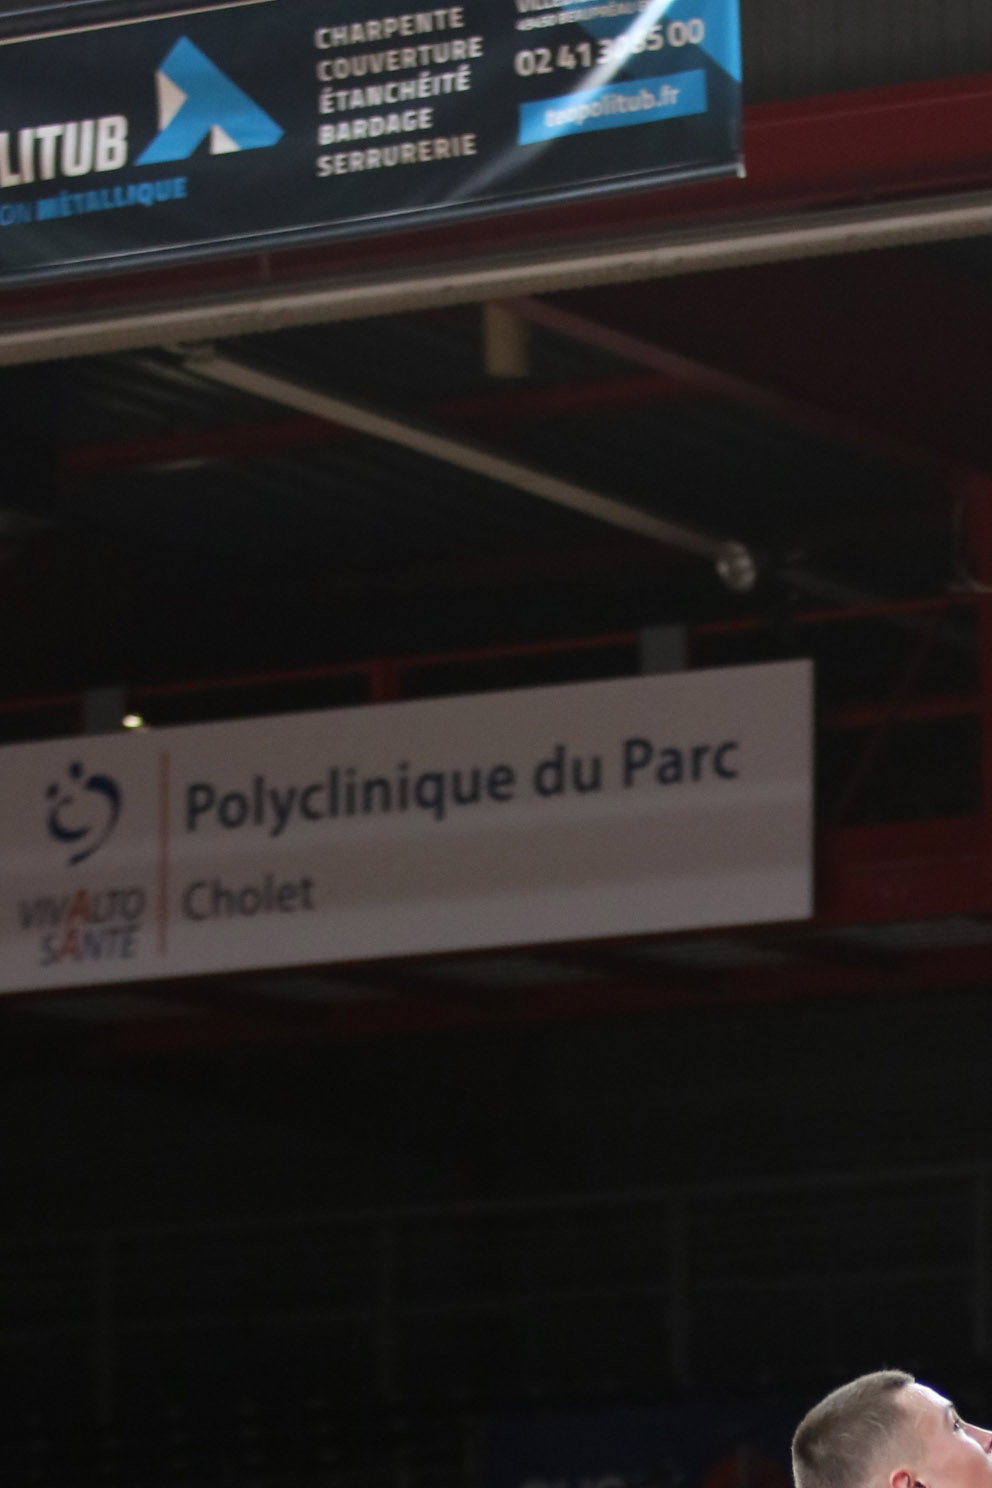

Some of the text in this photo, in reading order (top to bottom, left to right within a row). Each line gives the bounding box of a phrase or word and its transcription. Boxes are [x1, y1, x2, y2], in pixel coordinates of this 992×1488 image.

[314, 6, 465, 49] CHARPENTE
[316, 35, 484, 82] COUVERTURE
[318, 63, 473, 115] ÉTANCHÉITÉ
[317, 107, 435, 146] BARDAGE
[316, 132, 479, 178] SERRURERIE
[37, 176, 188, 220] MÉTALLIQUE
[186, 736, 740, 838] Polyclinique du Parc
[181, 873, 316, 922] Cholet
